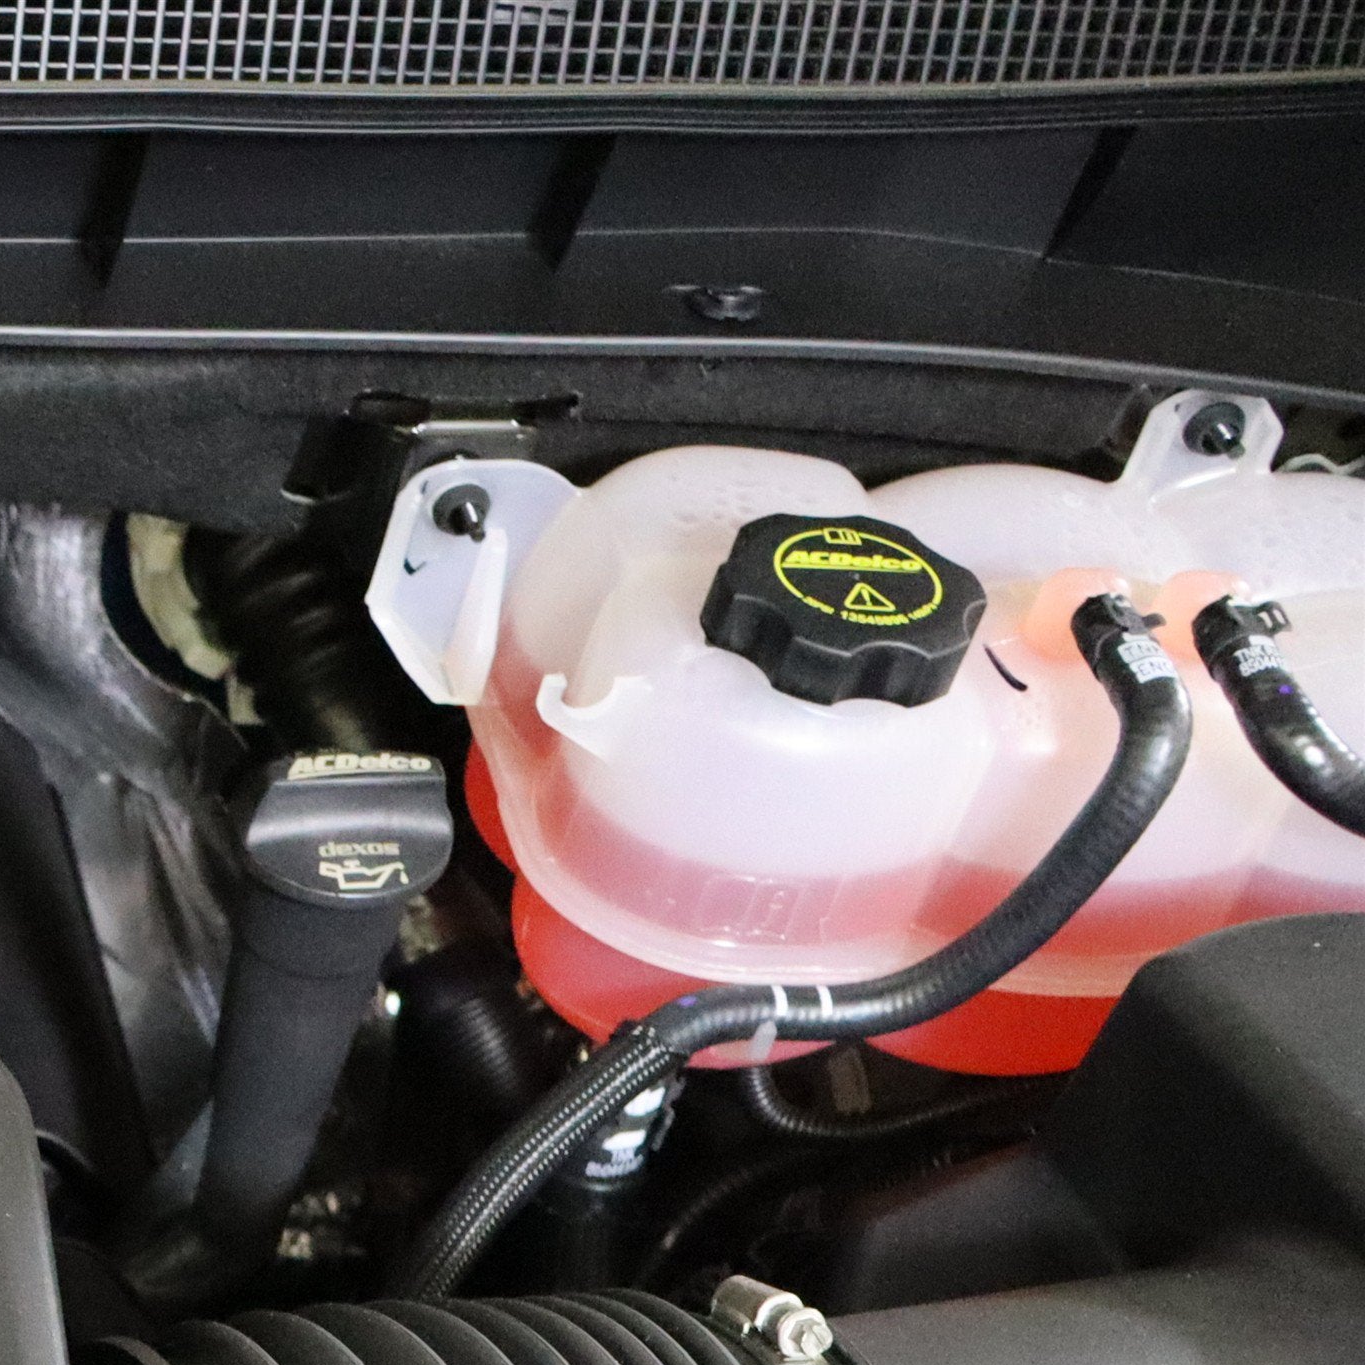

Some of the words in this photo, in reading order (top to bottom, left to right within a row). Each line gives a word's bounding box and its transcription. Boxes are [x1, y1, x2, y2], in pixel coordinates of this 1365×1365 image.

[782, 550, 922, 572] ACDelco
[288, 753, 432, 779] ACDelco
[319, 842, 400, 857] dexos
